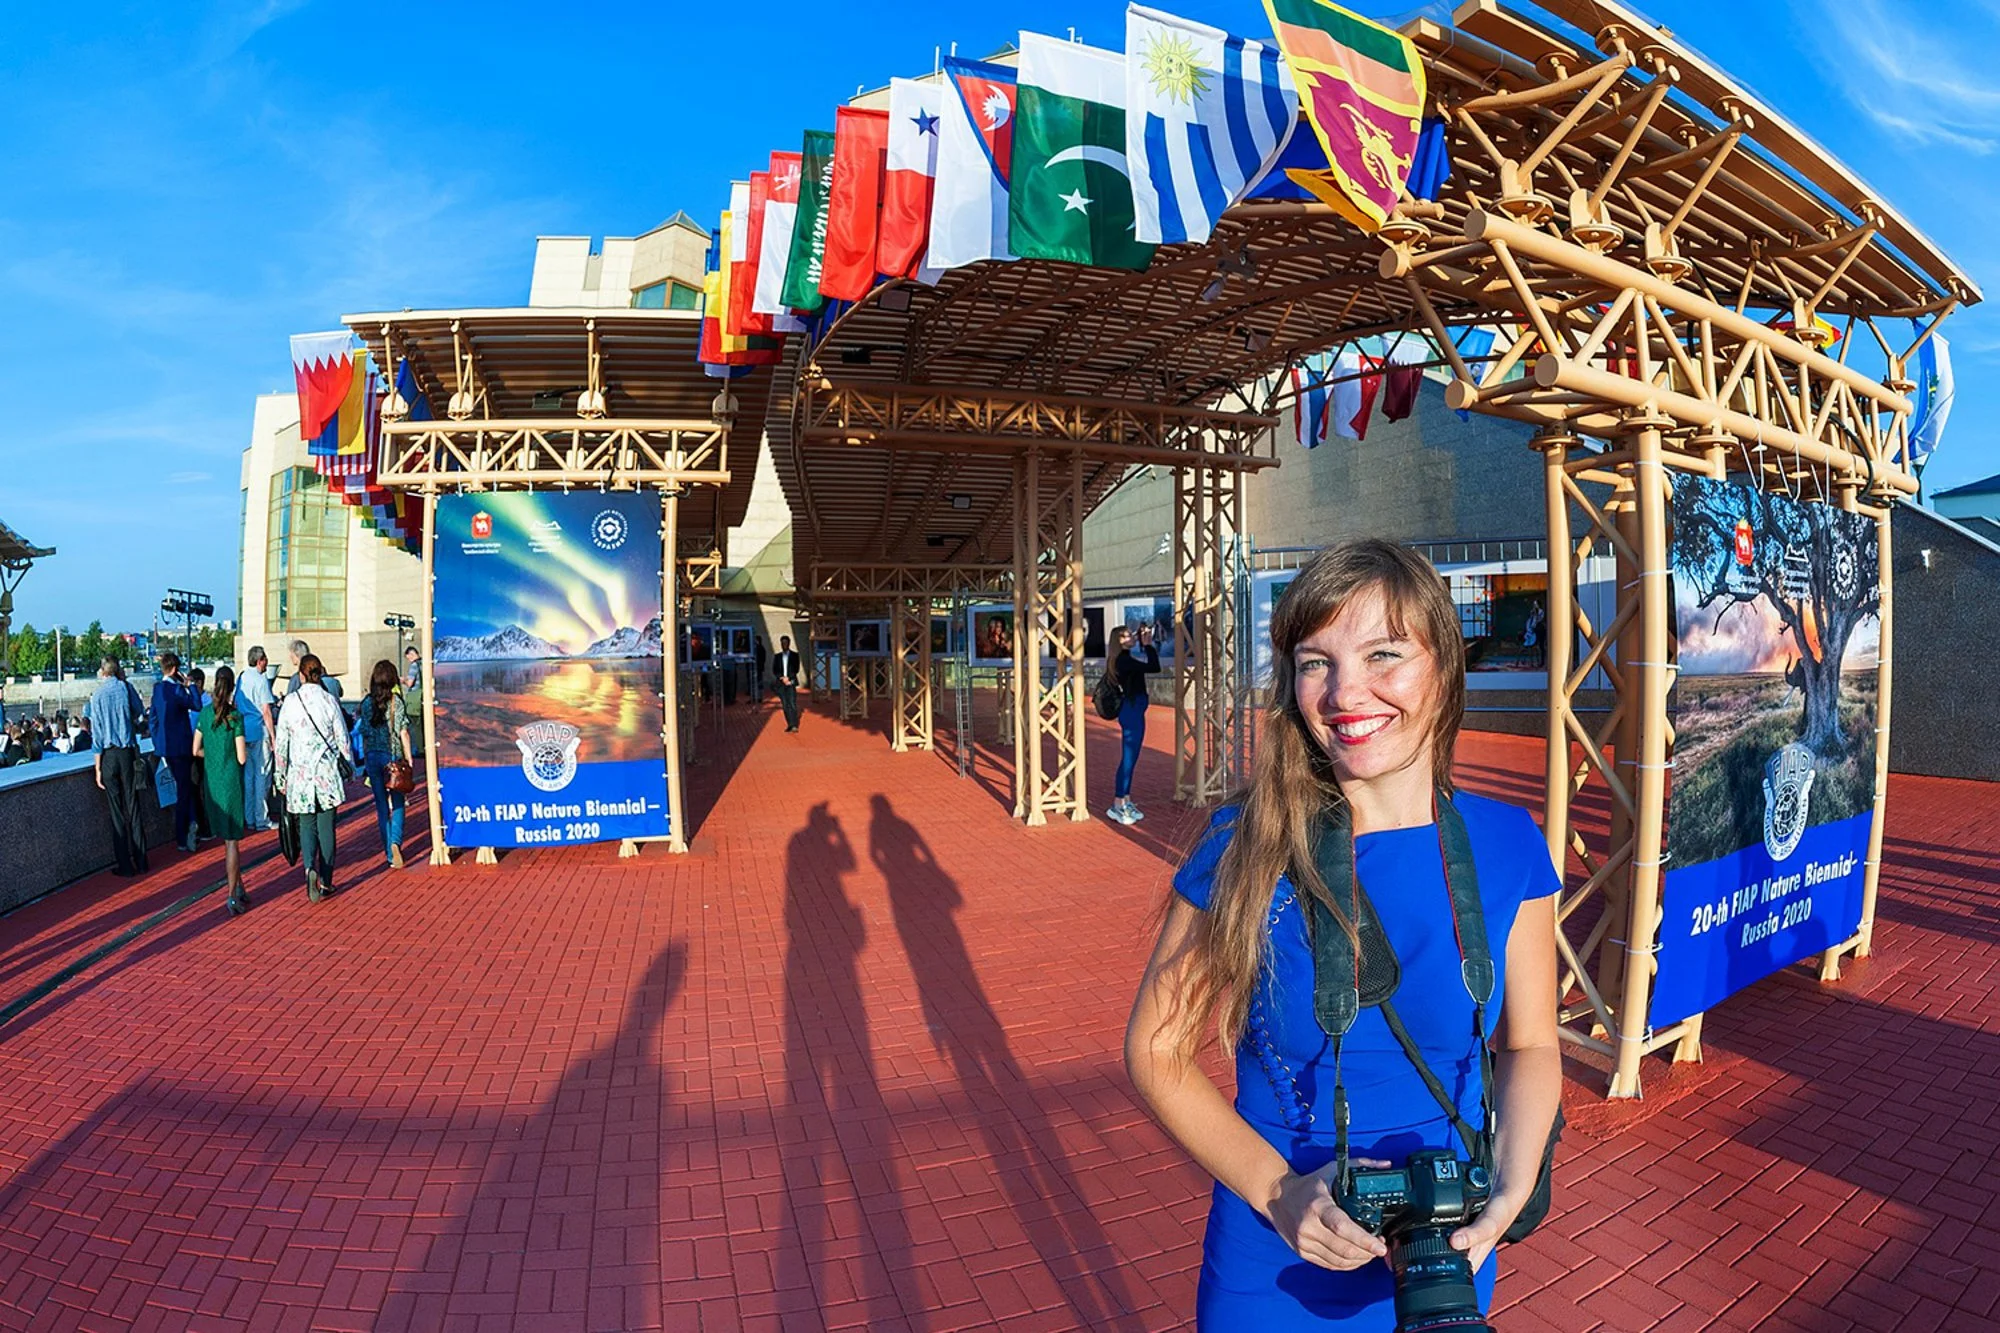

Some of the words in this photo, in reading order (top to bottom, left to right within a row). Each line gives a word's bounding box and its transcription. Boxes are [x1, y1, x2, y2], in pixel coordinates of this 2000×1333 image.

[526, 723, 573, 748] FIAP
[1771, 748, 1809, 790] FIAP
[455, 805, 491, 823] 20-th
[495, 803, 527, 822] FIAP
[532, 800, 581, 820] Nature
[515, 824, 561, 844] Russia
[566, 822, 600, 840] 2020
[1690, 896, 1729, 937] 20-th
[1731, 882, 1758, 919] FIAP
[1761, 872, 1801, 905] Nature
[1741, 911, 1779, 949] Russia
[1781, 896, 1812, 931] 2020
